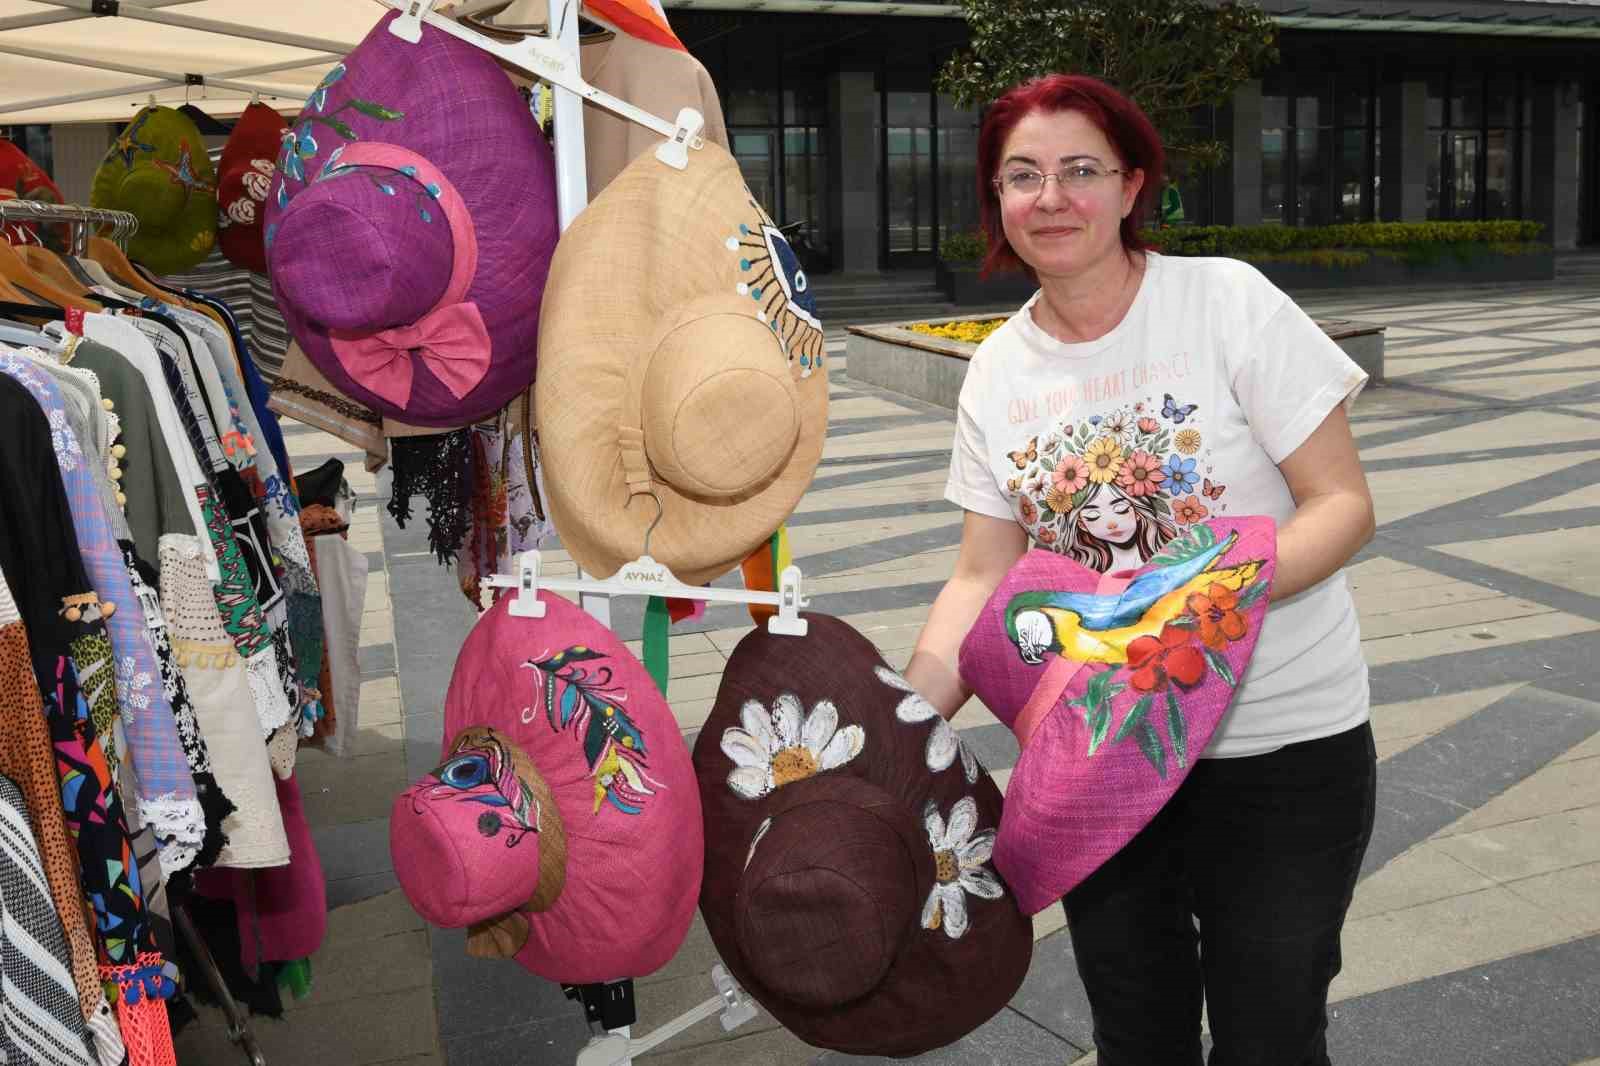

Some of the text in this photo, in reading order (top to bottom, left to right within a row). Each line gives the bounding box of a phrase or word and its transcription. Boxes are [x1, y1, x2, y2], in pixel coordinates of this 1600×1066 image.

[1008, 398, 1040, 424] GIVE
[1082, 369, 1126, 403] HEART
[623, 570, 665, 583] AYNAZ
